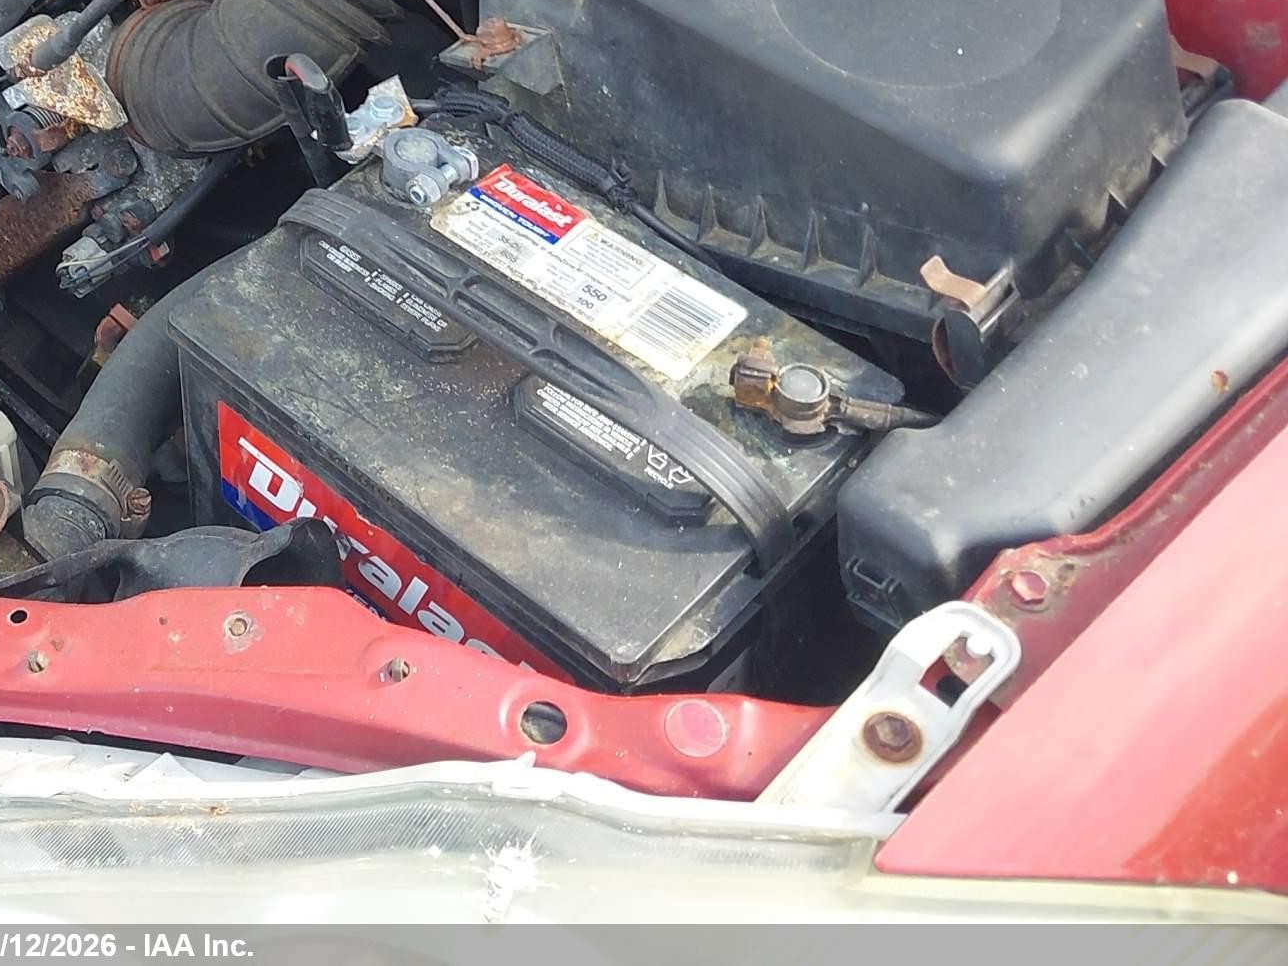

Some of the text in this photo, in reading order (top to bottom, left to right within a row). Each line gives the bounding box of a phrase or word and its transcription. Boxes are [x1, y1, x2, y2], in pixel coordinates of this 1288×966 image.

[493, 174, 573, 228] Duralast
[582, 284, 607, 302] 550
[576, 297, 594, 310] 100
